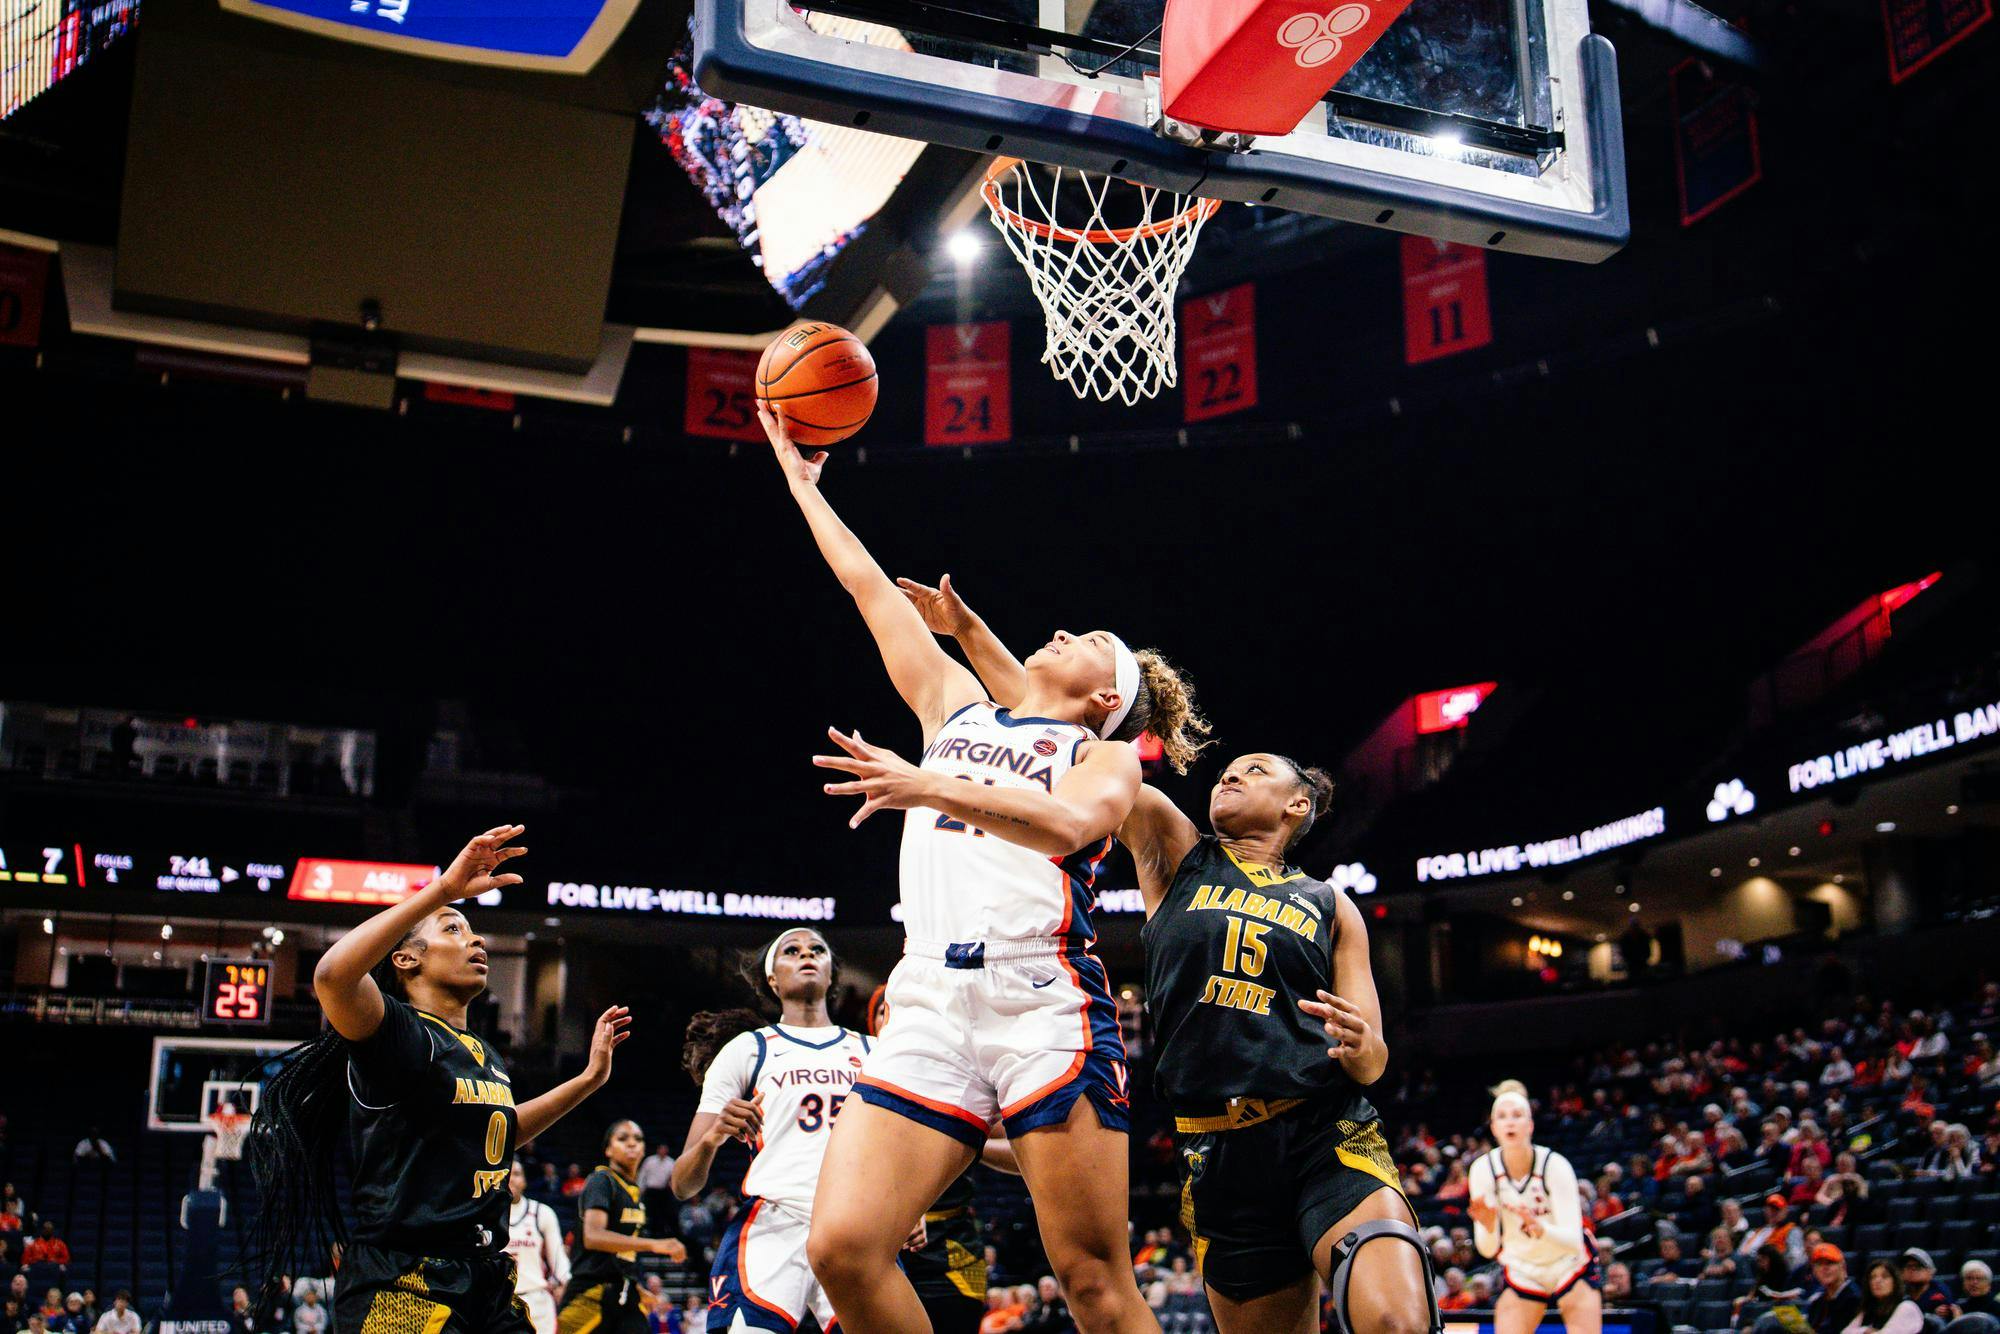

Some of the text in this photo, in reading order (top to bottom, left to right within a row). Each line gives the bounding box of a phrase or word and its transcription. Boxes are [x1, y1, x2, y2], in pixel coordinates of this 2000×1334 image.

[1429, 300, 1465, 347] 11
[1200, 362, 1243, 408] 22
[704, 388, 753, 430] 25
[943, 395, 992, 434] 24
[928, 737, 1053, 795] VIRGINIA
[1789, 755, 1835, 793] FOR
[1834, 719, 1955, 779] LIVE-WELL
[42, 847, 64, 874] 7
[94, 853, 134, 871] FOULS
[246, 862, 285, 880] FOULS
[312, 863, 334, 890] 3
[1417, 853, 1467, 882] FOR
[1467, 834, 1583, 876] LIVE-WELL
[362, 870, 408, 893] ASU
[547, 882, 836, 921] FOR LIVE-WELL BANKING!
[1186, 885, 1318, 943] ALABAMA
[1222, 915, 1273, 978] 15
[215, 983, 258, 1019] 25
[1198, 974, 1277, 1016] STATE
[485, 1110, 507, 1165] 0
[175, 1320, 230, 1333] UNITED
